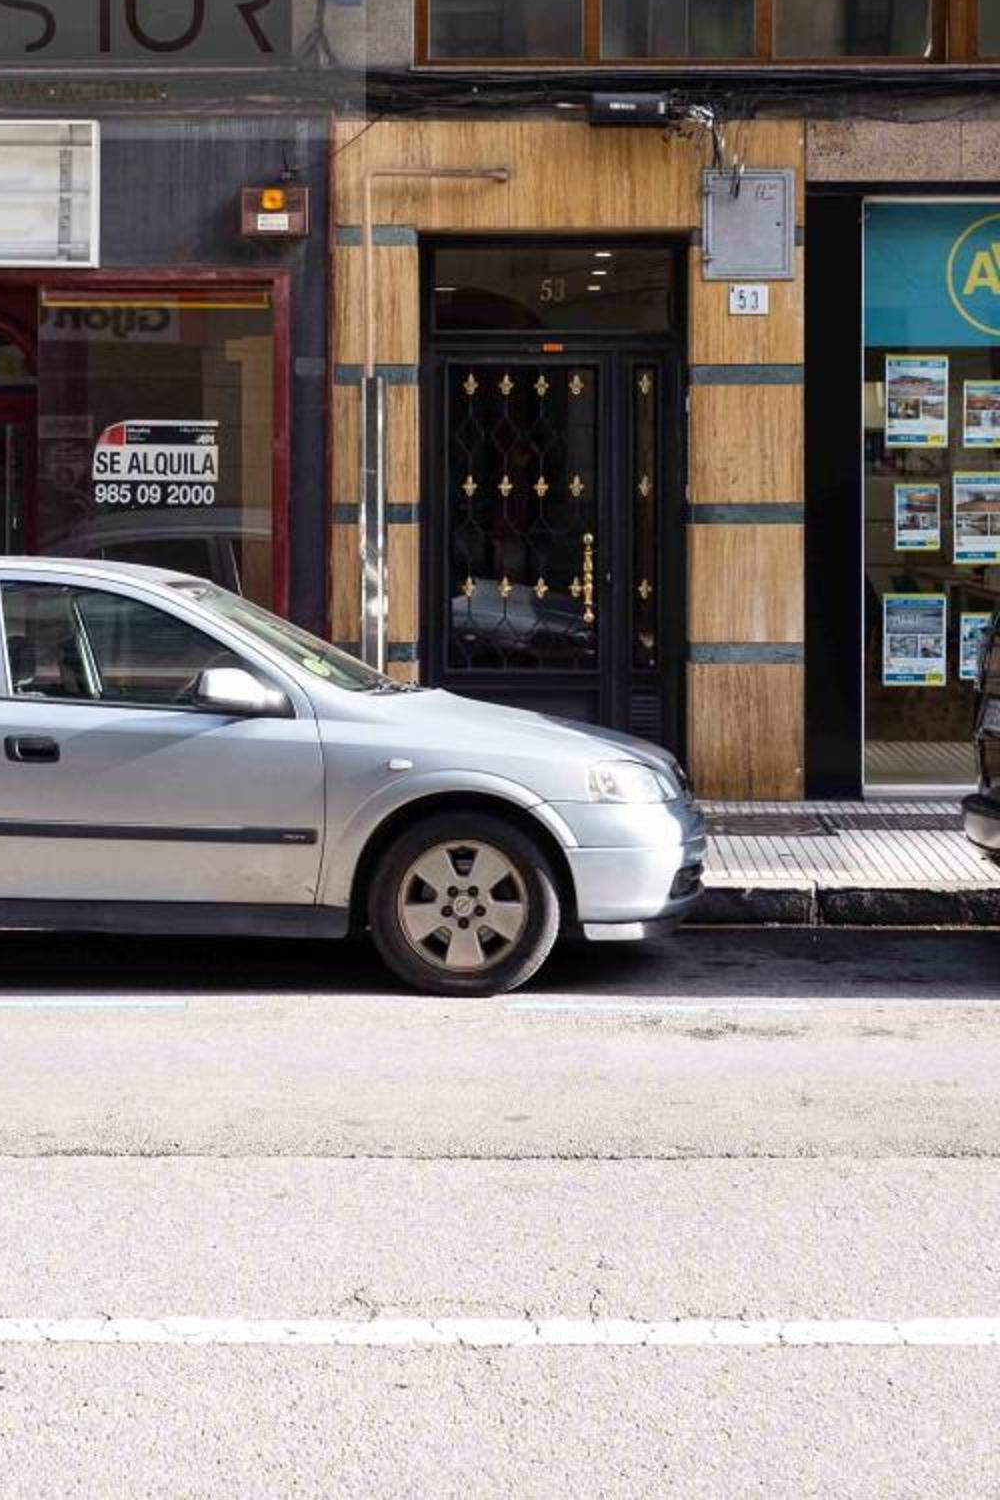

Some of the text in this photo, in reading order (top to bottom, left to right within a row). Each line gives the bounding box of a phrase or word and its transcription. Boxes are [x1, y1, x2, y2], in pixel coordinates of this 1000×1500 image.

[539, 277, 566, 302] 53
[736, 289, 760, 311] 53
[95, 451, 215, 477] SE ALQUILA
[95, 484, 216, 505] 985 09 2000
